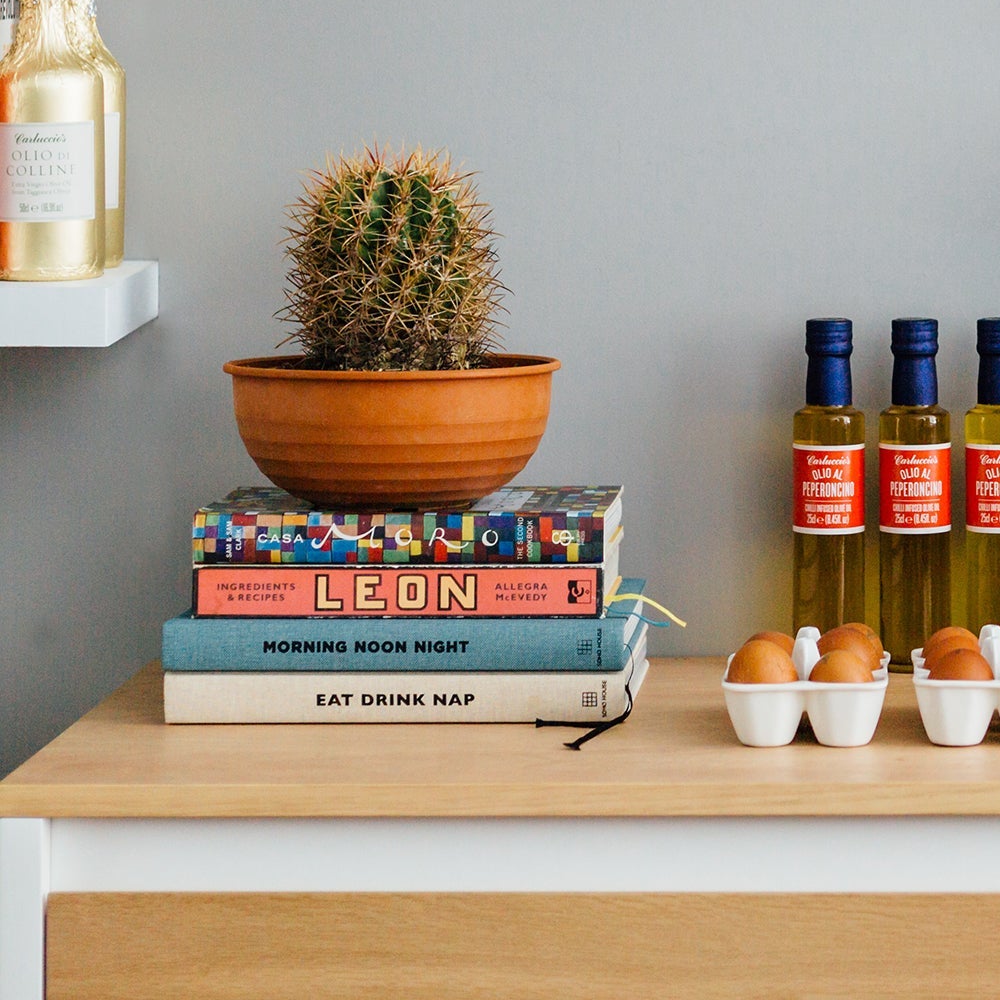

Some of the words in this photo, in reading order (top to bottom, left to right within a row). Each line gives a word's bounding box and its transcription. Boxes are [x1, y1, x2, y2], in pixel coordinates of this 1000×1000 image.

[14, 133, 66, 145] Carluccio's
[12, 150, 52, 161] OLIO
[807, 455, 850, 465] Carluccio's
[894, 455, 938, 465] Carluccio's
[812, 468, 832, 480] OLIO
[833, 469, 843, 480] AL
[900, 467, 920, 480] OLIO
[921, 468, 931, 480] AL
[802, 482, 855, 497] PEPERONCINO
[890, 481, 942, 497] PEPERONCINO
[257, 534, 304, 543] CASA
[314, 574, 477, 611] LEON
[263, 640, 347, 654] MORNING
[354, 641, 406, 654] NOON
[414, 641, 469, 653] NIGHT
[316, 694, 353, 706] EAT
[361, 694, 425, 706] DRINK
[433, 694, 475, 706] NAP
